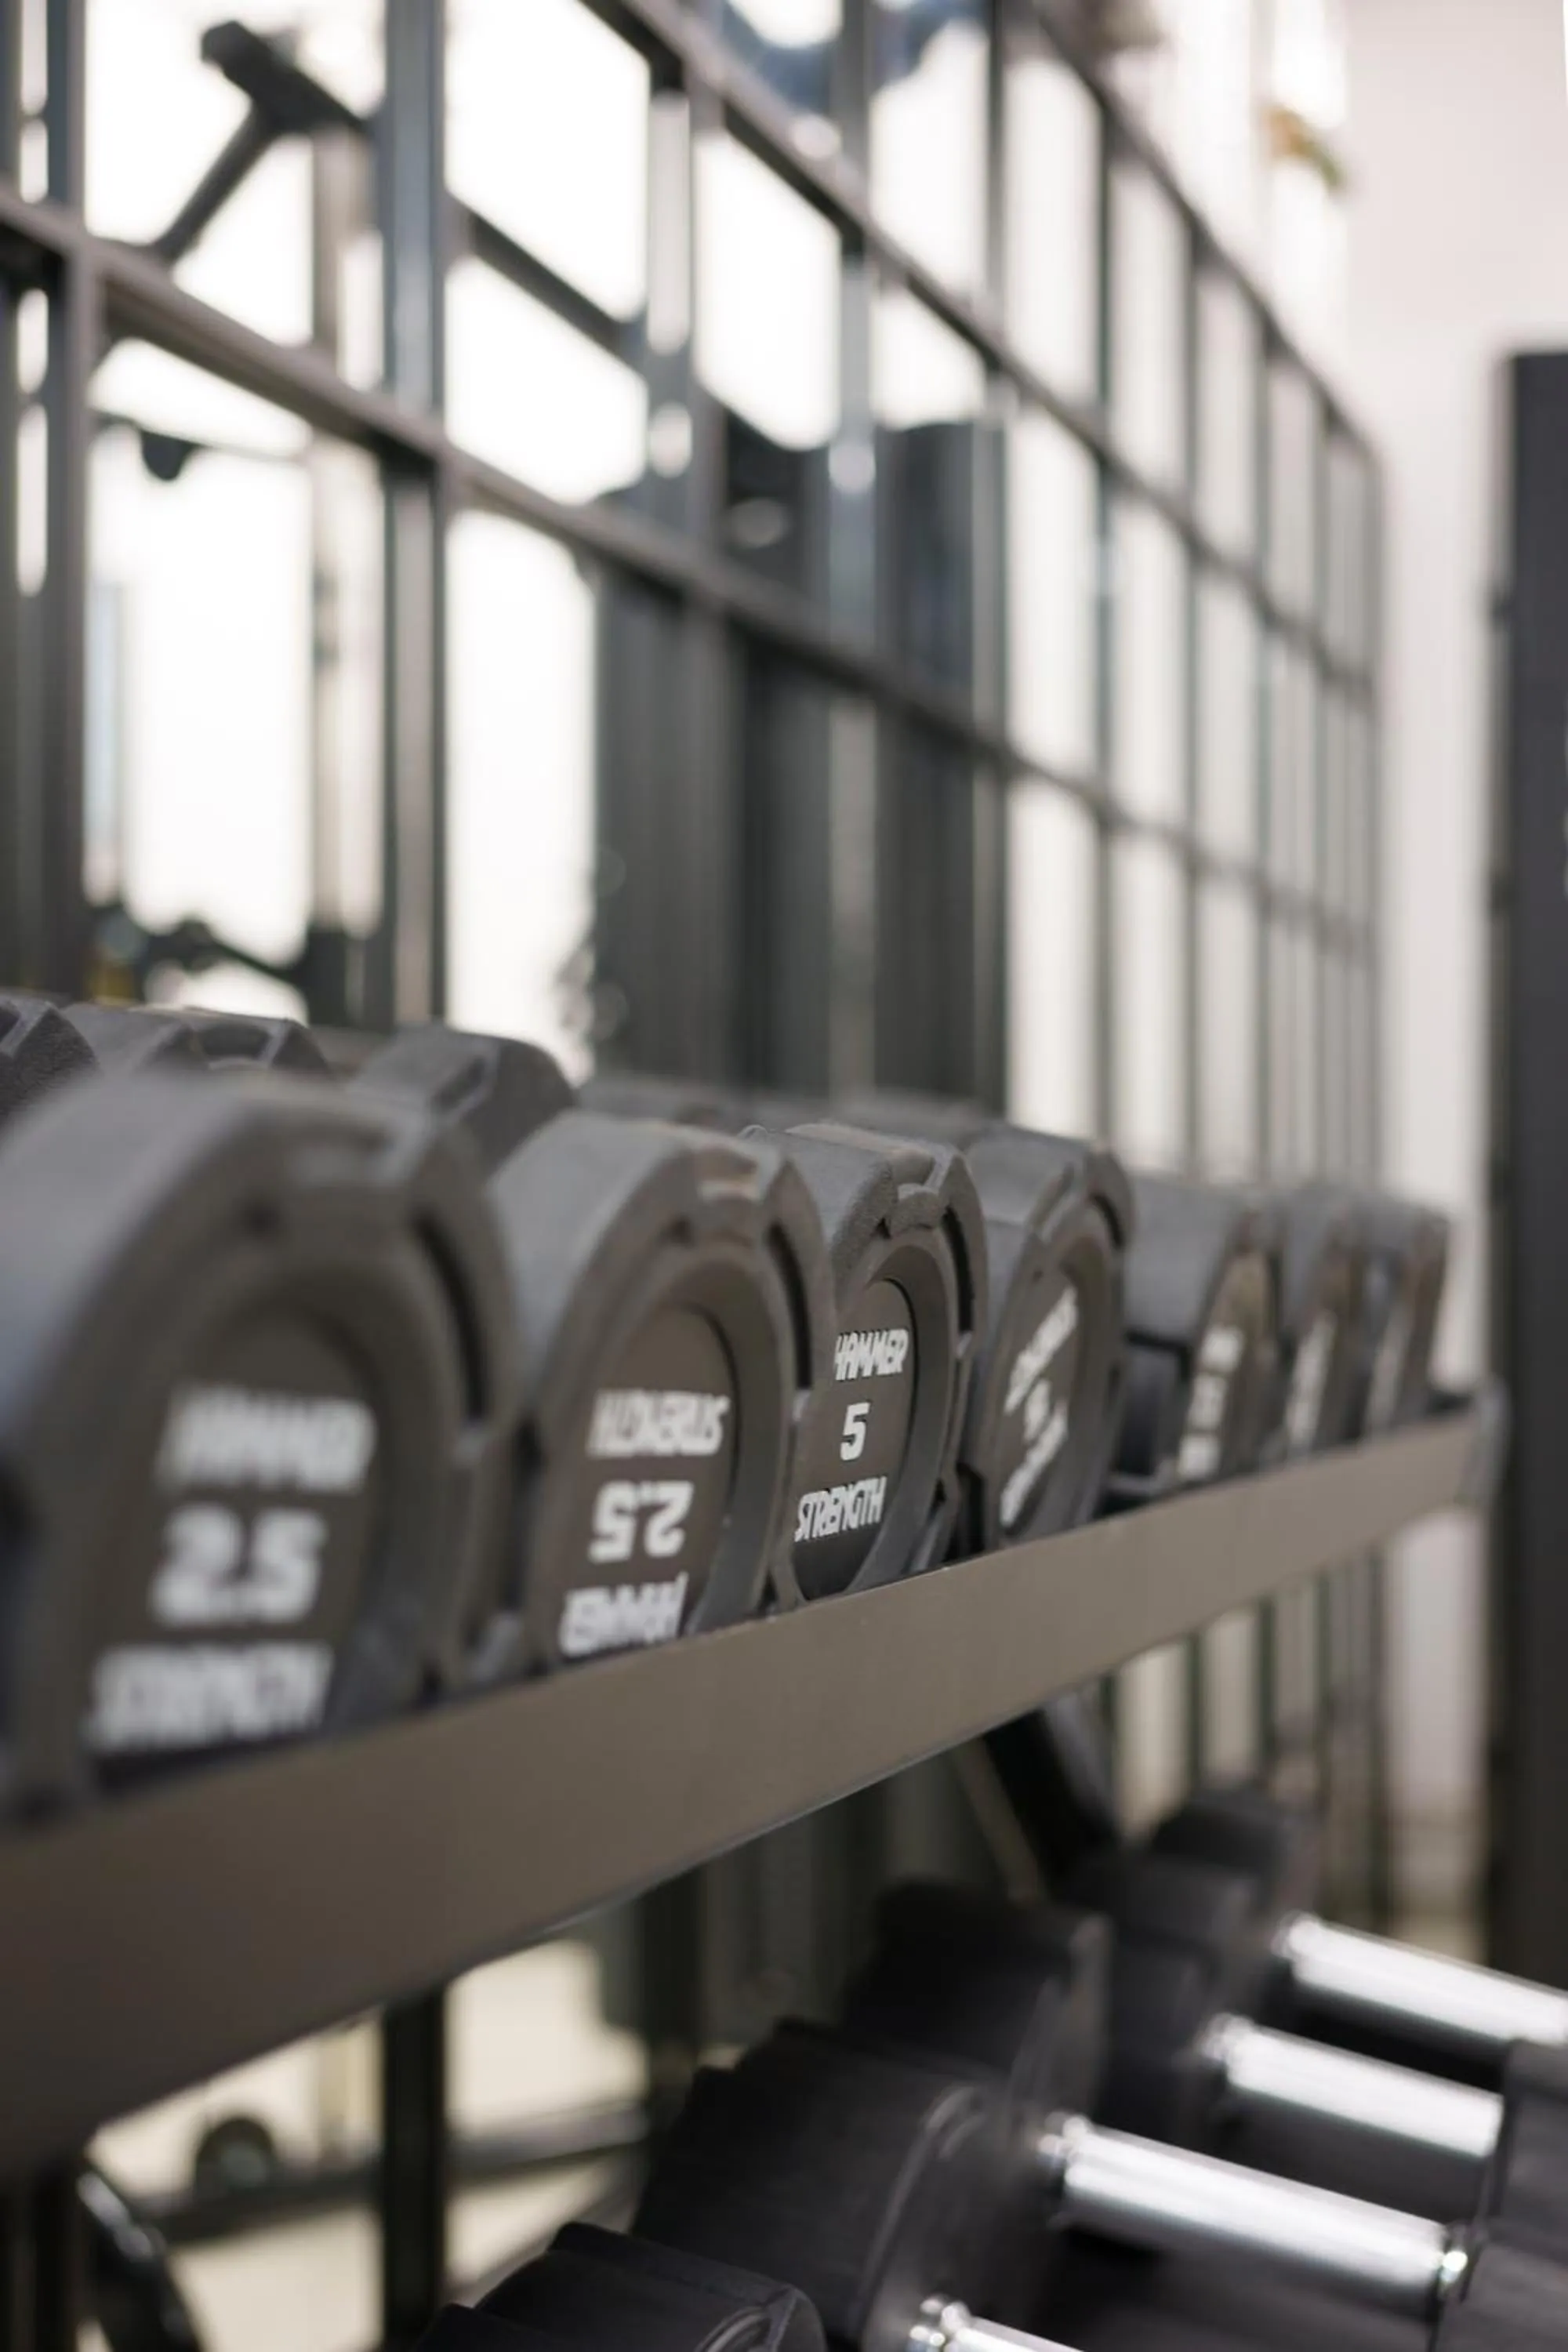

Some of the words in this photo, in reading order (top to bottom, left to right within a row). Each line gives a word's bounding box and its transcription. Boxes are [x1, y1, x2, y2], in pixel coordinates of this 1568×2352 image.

[833, 1329, 909, 1381] HAMMER
[840, 1401, 871, 1461] 5
[793, 1475, 887, 1543] STRENGTH
